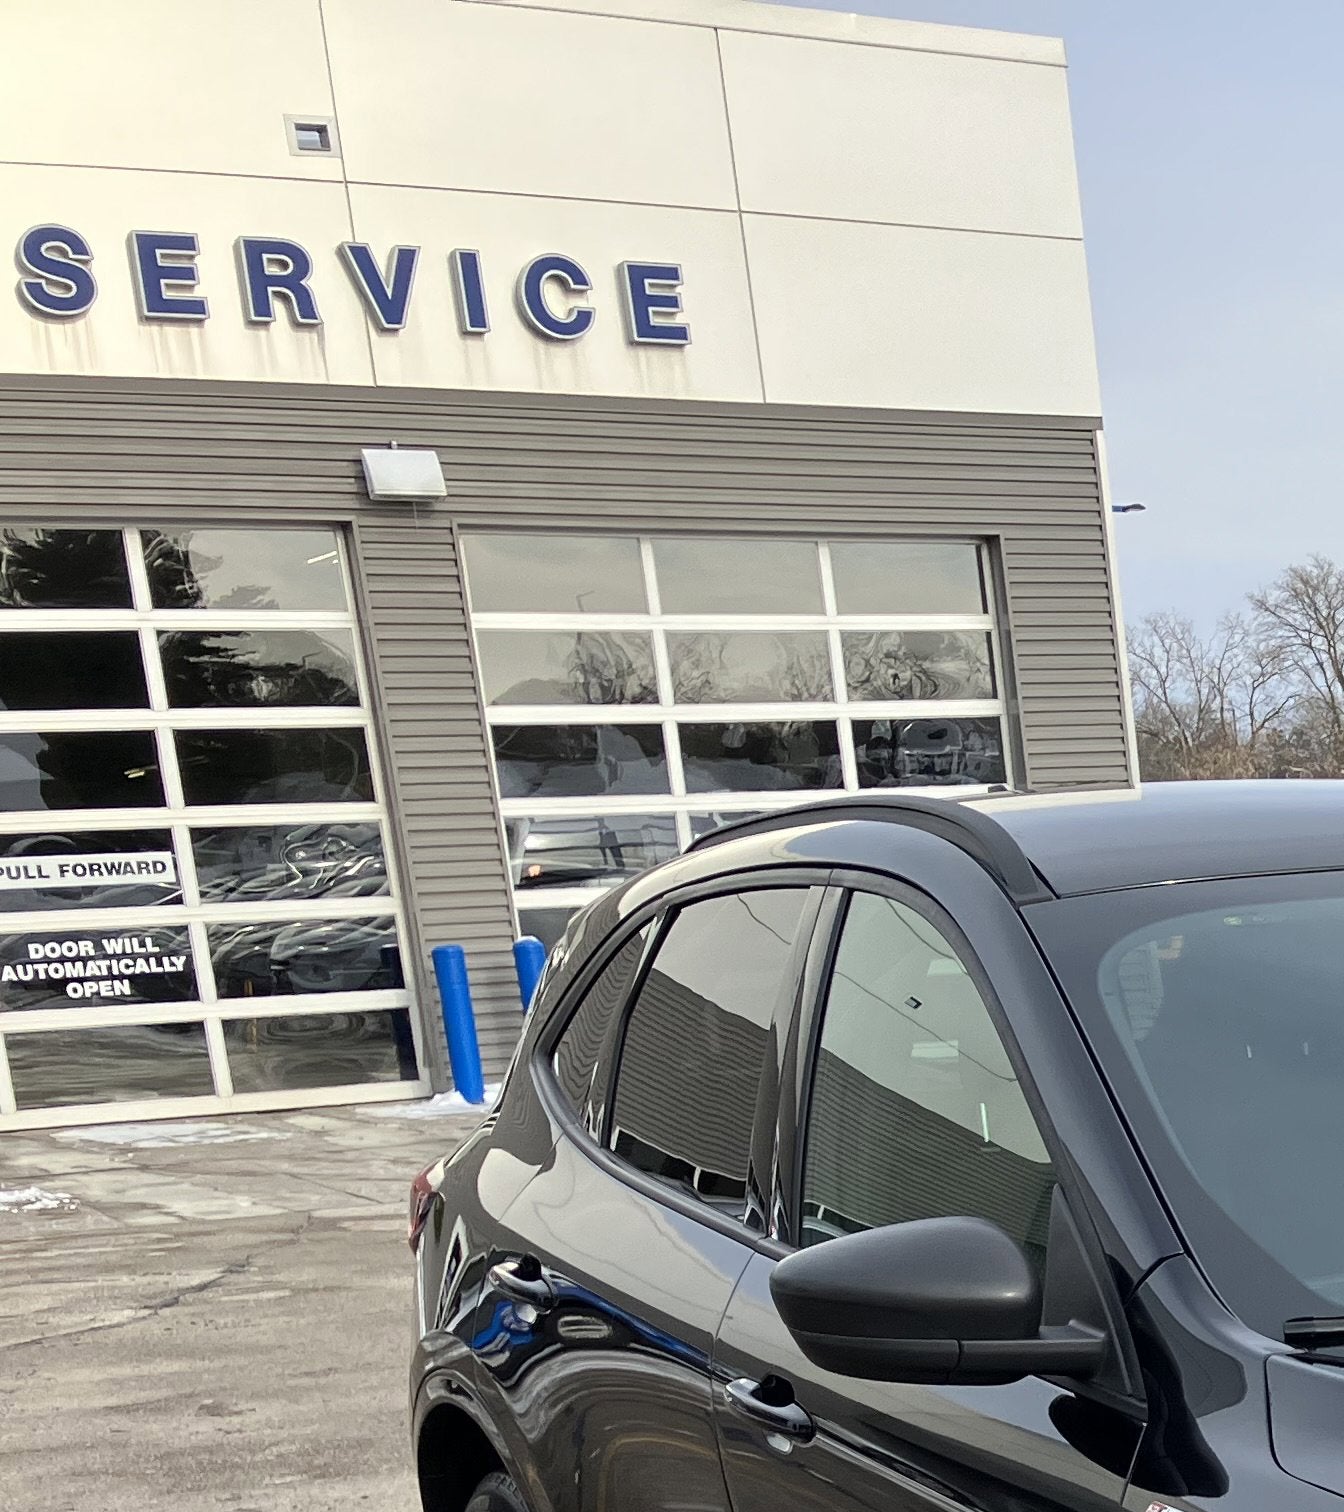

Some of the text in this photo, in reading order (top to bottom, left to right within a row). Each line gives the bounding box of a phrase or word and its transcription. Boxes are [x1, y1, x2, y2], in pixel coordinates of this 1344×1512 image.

[15, 223, 693, 346] SERVICE
[58, 860, 167, 878] FORWARD
[28, 937, 160, 959] DOOR WILL
[2, 955, 187, 982] AUTOMATICALLY
[66, 979, 131, 998] OPEN
